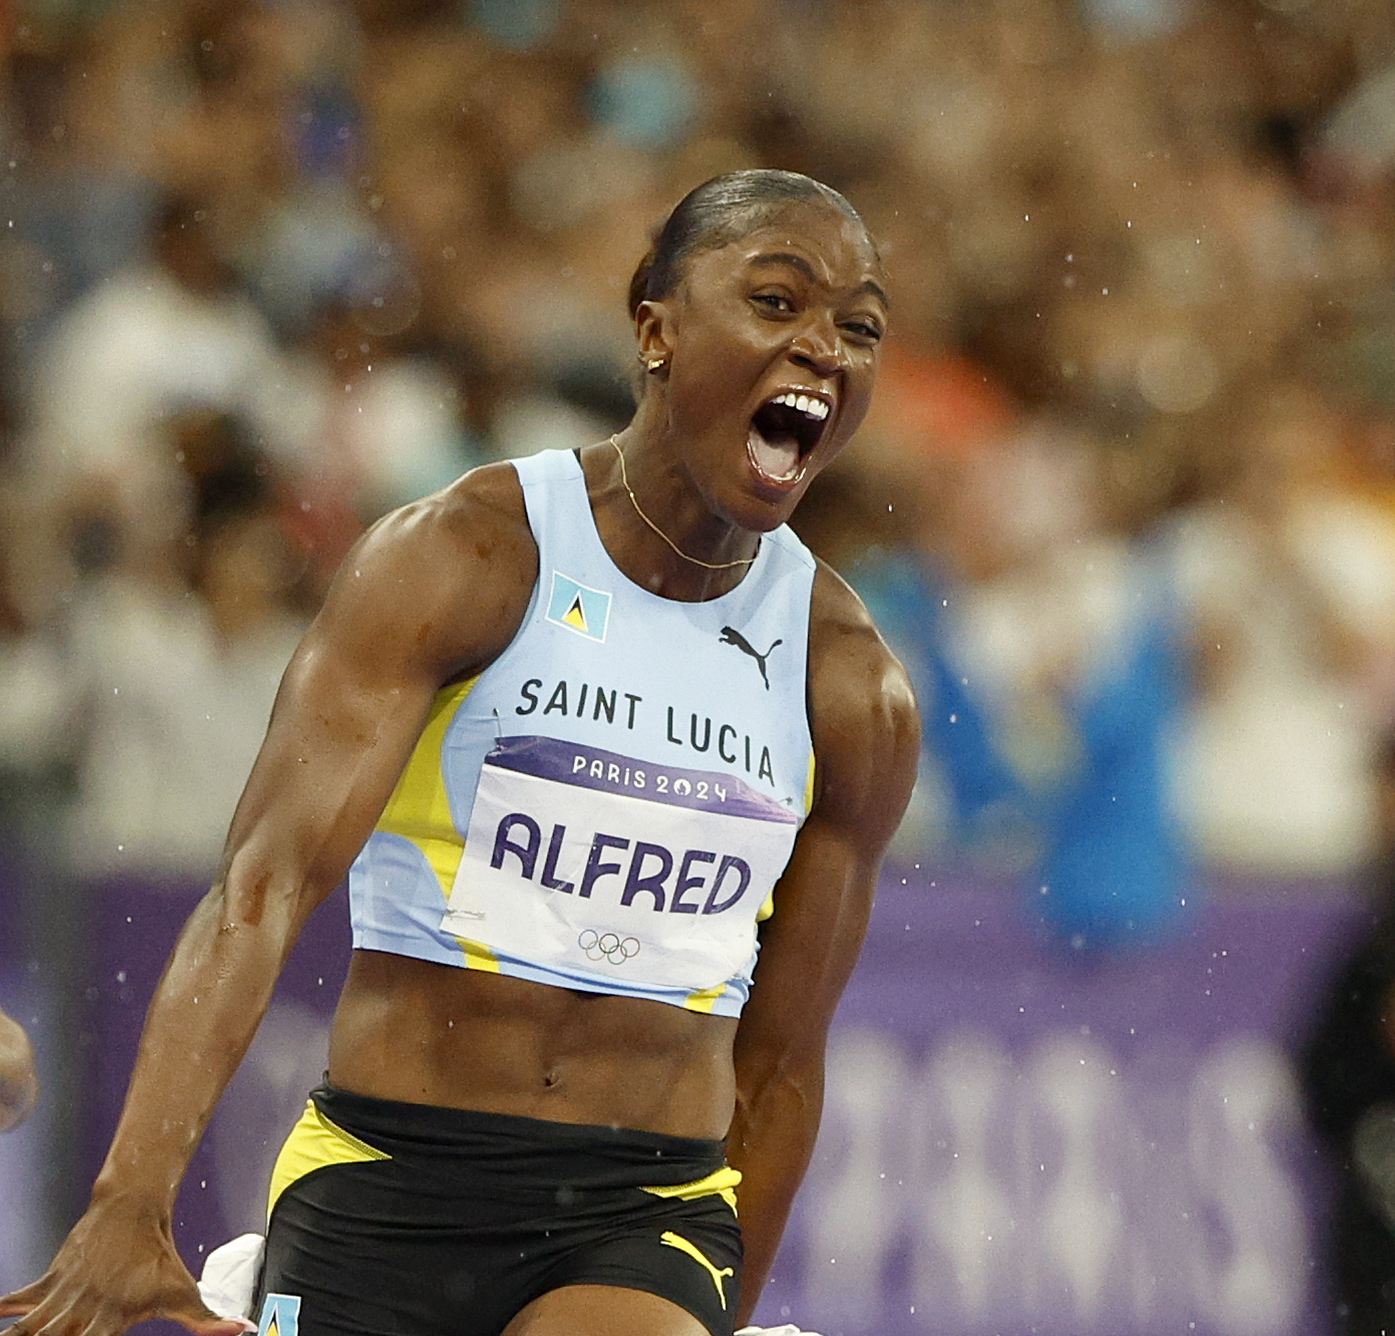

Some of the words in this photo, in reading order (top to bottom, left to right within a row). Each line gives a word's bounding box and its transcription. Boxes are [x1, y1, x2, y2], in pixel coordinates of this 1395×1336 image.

[515, 678, 643, 730] SAINT
[666, 705, 776, 788] LUCIA
[656, 775, 727, 802] 2024
[489, 811, 752, 916] ALFRED
